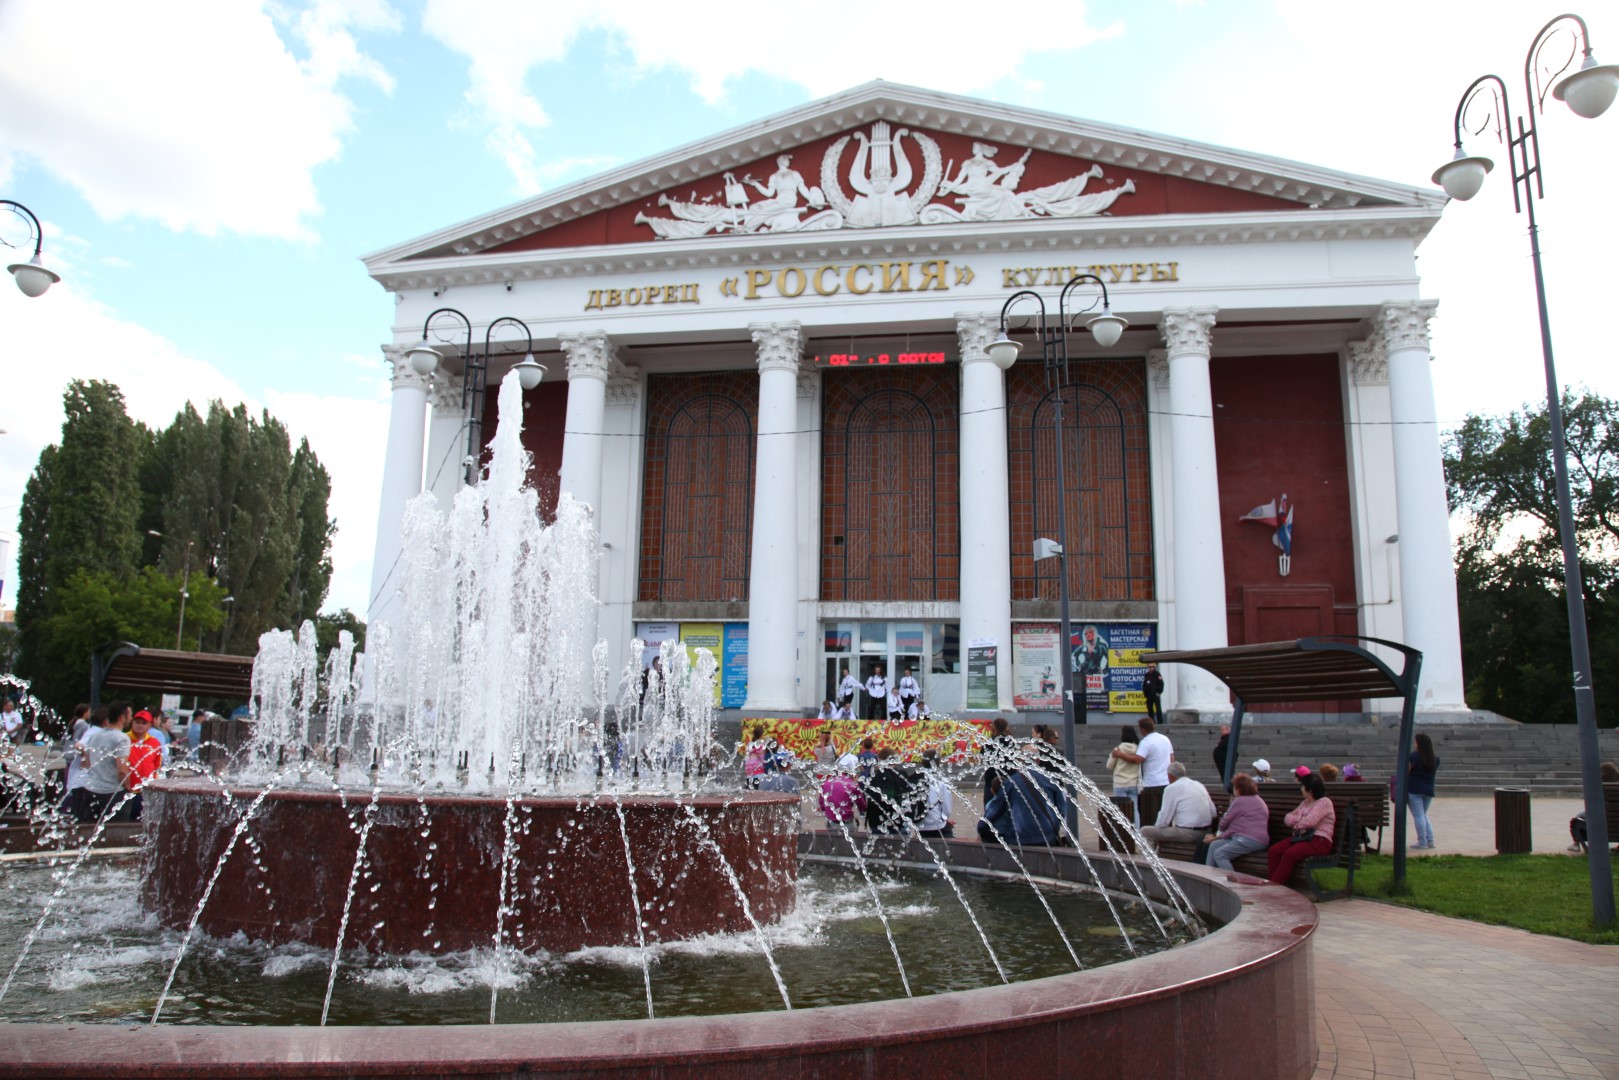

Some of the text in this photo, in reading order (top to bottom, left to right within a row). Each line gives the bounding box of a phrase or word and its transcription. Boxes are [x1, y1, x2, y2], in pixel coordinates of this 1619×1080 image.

[584, 260, 1179, 310] ДВОРЕЦ «РОССИЯ» КУЛЬТУРЫ
